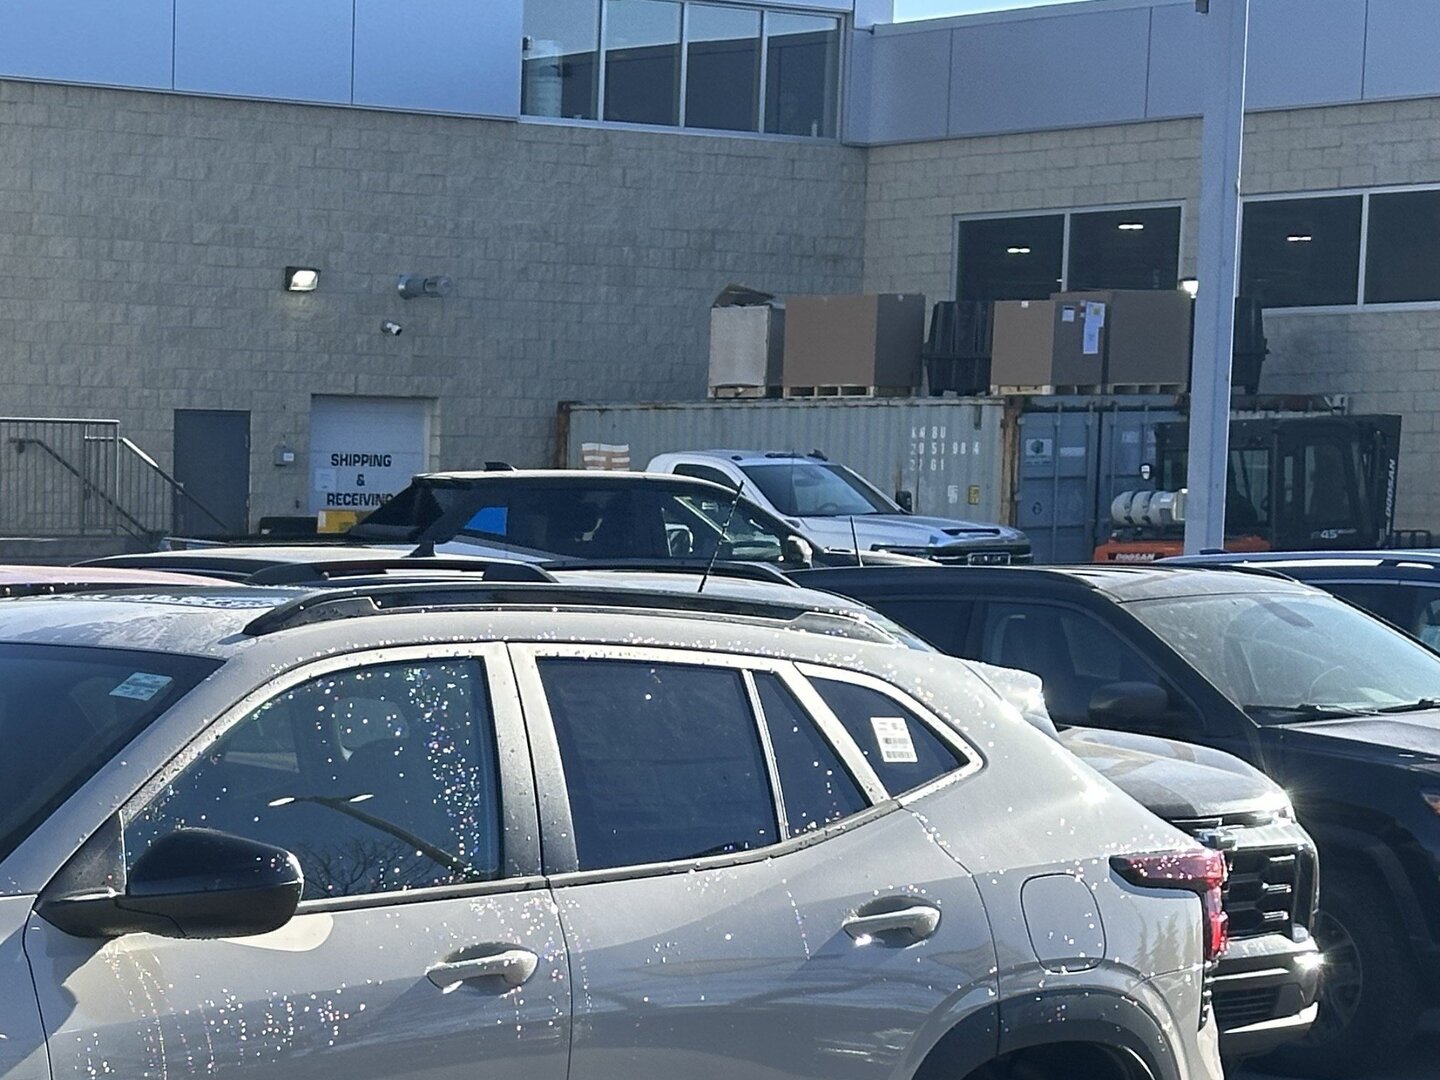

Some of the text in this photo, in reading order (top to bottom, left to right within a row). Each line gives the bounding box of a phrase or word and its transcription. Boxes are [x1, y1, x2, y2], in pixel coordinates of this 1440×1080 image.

[330, 453, 393, 468] SHIPPING
[356, 473, 366, 487] &
[1384, 458, 1396, 518] DOOSAN
[1115, 552, 1156, 561] DOOSAN
